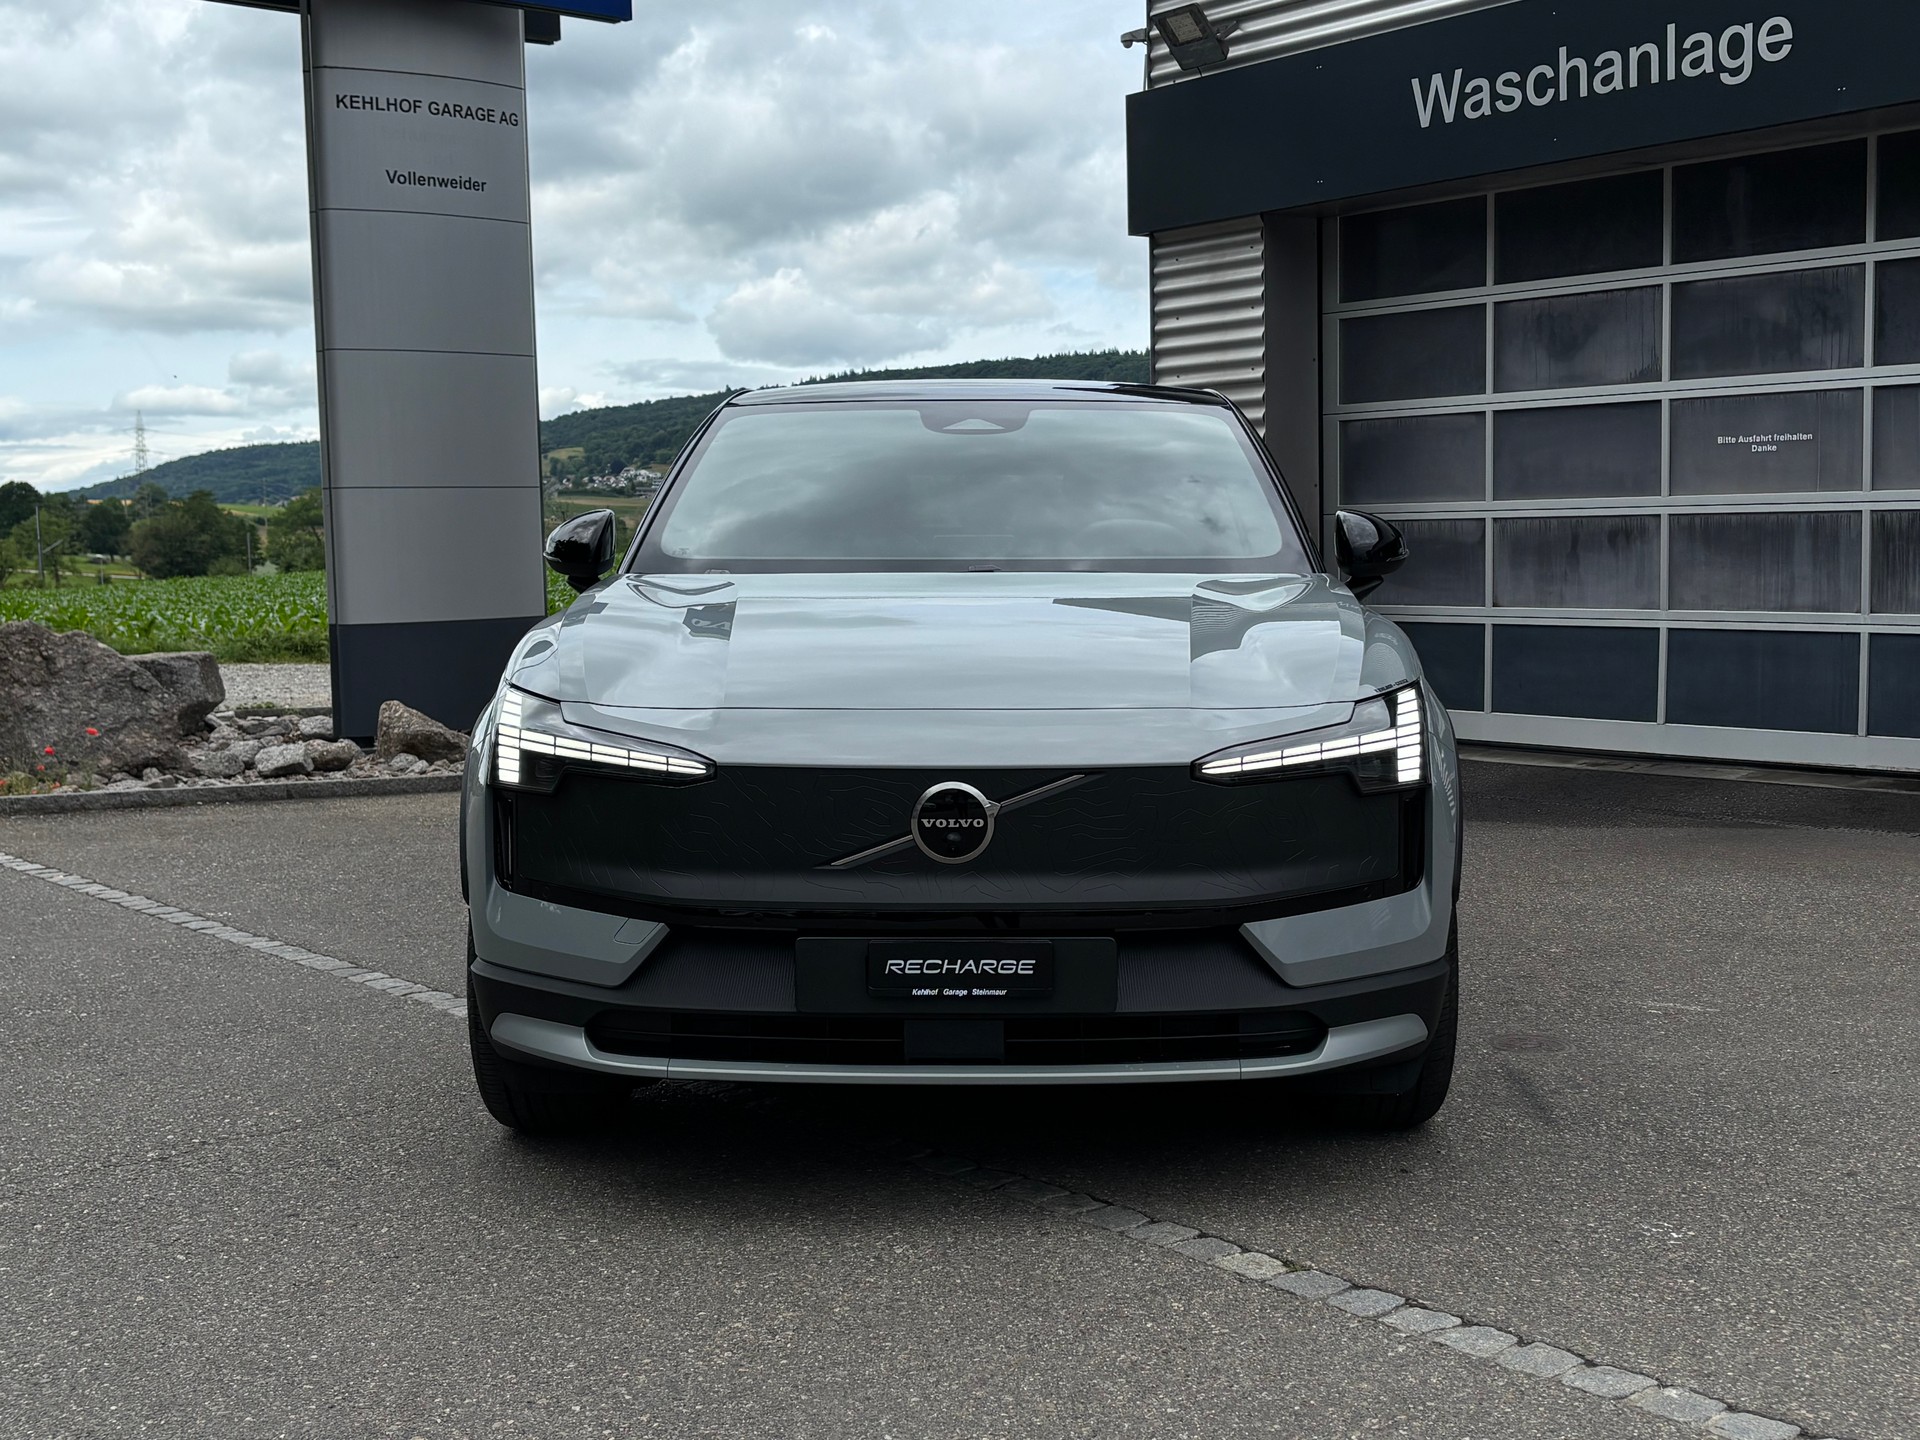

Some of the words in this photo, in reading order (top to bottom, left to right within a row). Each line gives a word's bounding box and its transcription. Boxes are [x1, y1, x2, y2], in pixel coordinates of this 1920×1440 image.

[1411, 15, 1793, 128] Waschanlage
[336, 94, 422, 114] KEHLHOF
[428, 101, 496, 123] GARAGE
[499, 111, 519, 127] AG
[386, 169, 487, 192] Vollenweider
[1717, 436, 1737, 444] Bitte
[1738, 434, 1772, 443] Ausfahrt
[1773, 433, 1813, 442] freihalten
[1751, 444, 1778, 452] Danke
[921, 818, 985, 828] VOLVO
[885, 959, 1036, 975] RECHARGE
[912, 988, 939, 996] Kehlhof
[943, 988, 968, 997] Garage
[972, 988, 1008, 996] Steinmaur
